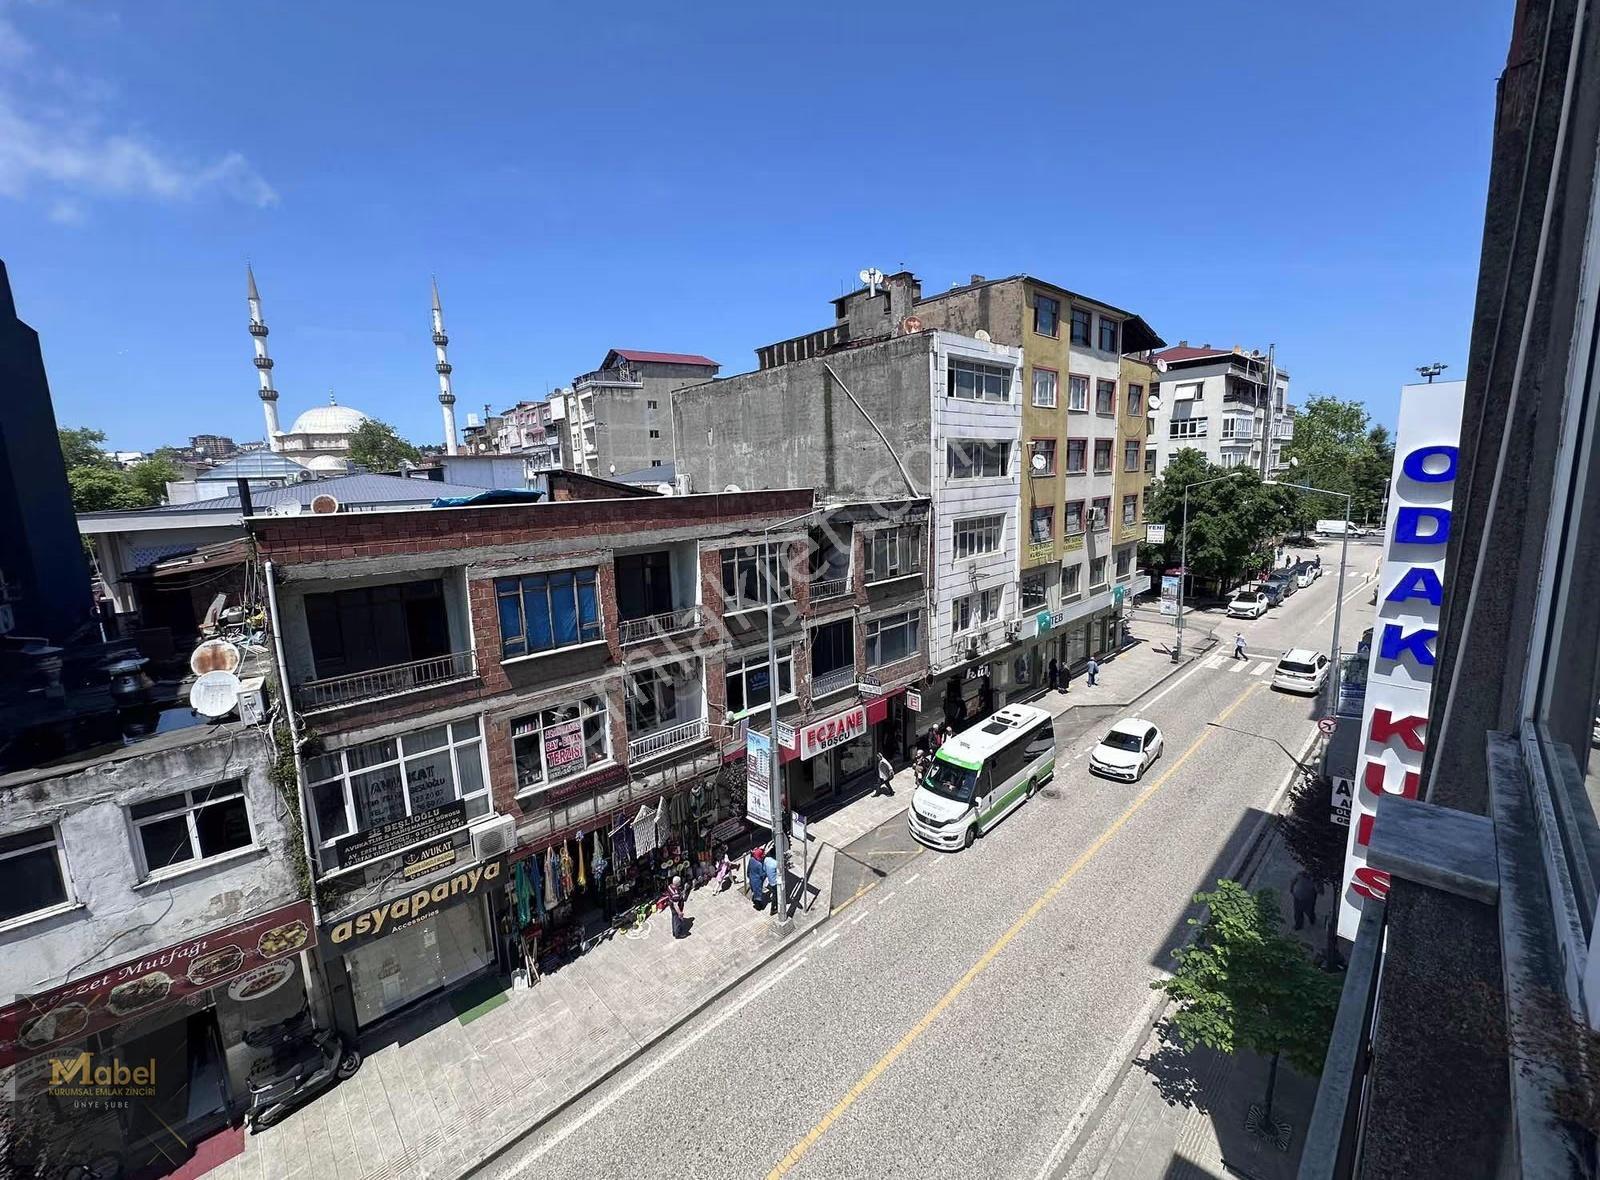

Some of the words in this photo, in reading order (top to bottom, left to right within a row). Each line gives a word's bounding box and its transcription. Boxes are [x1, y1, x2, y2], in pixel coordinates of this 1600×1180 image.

[1380, 445, 1460, 666] ODAK
[1051, 613, 1064, 626] TEB
[806, 710, 864, 749] ECZANE
[421, 841, 452, 860] AVUKAT
[330, 861, 500, 944] asyapanya
[391, 909, 440, 934] Accessories
[117, 941, 208, 982] Mutfağı
